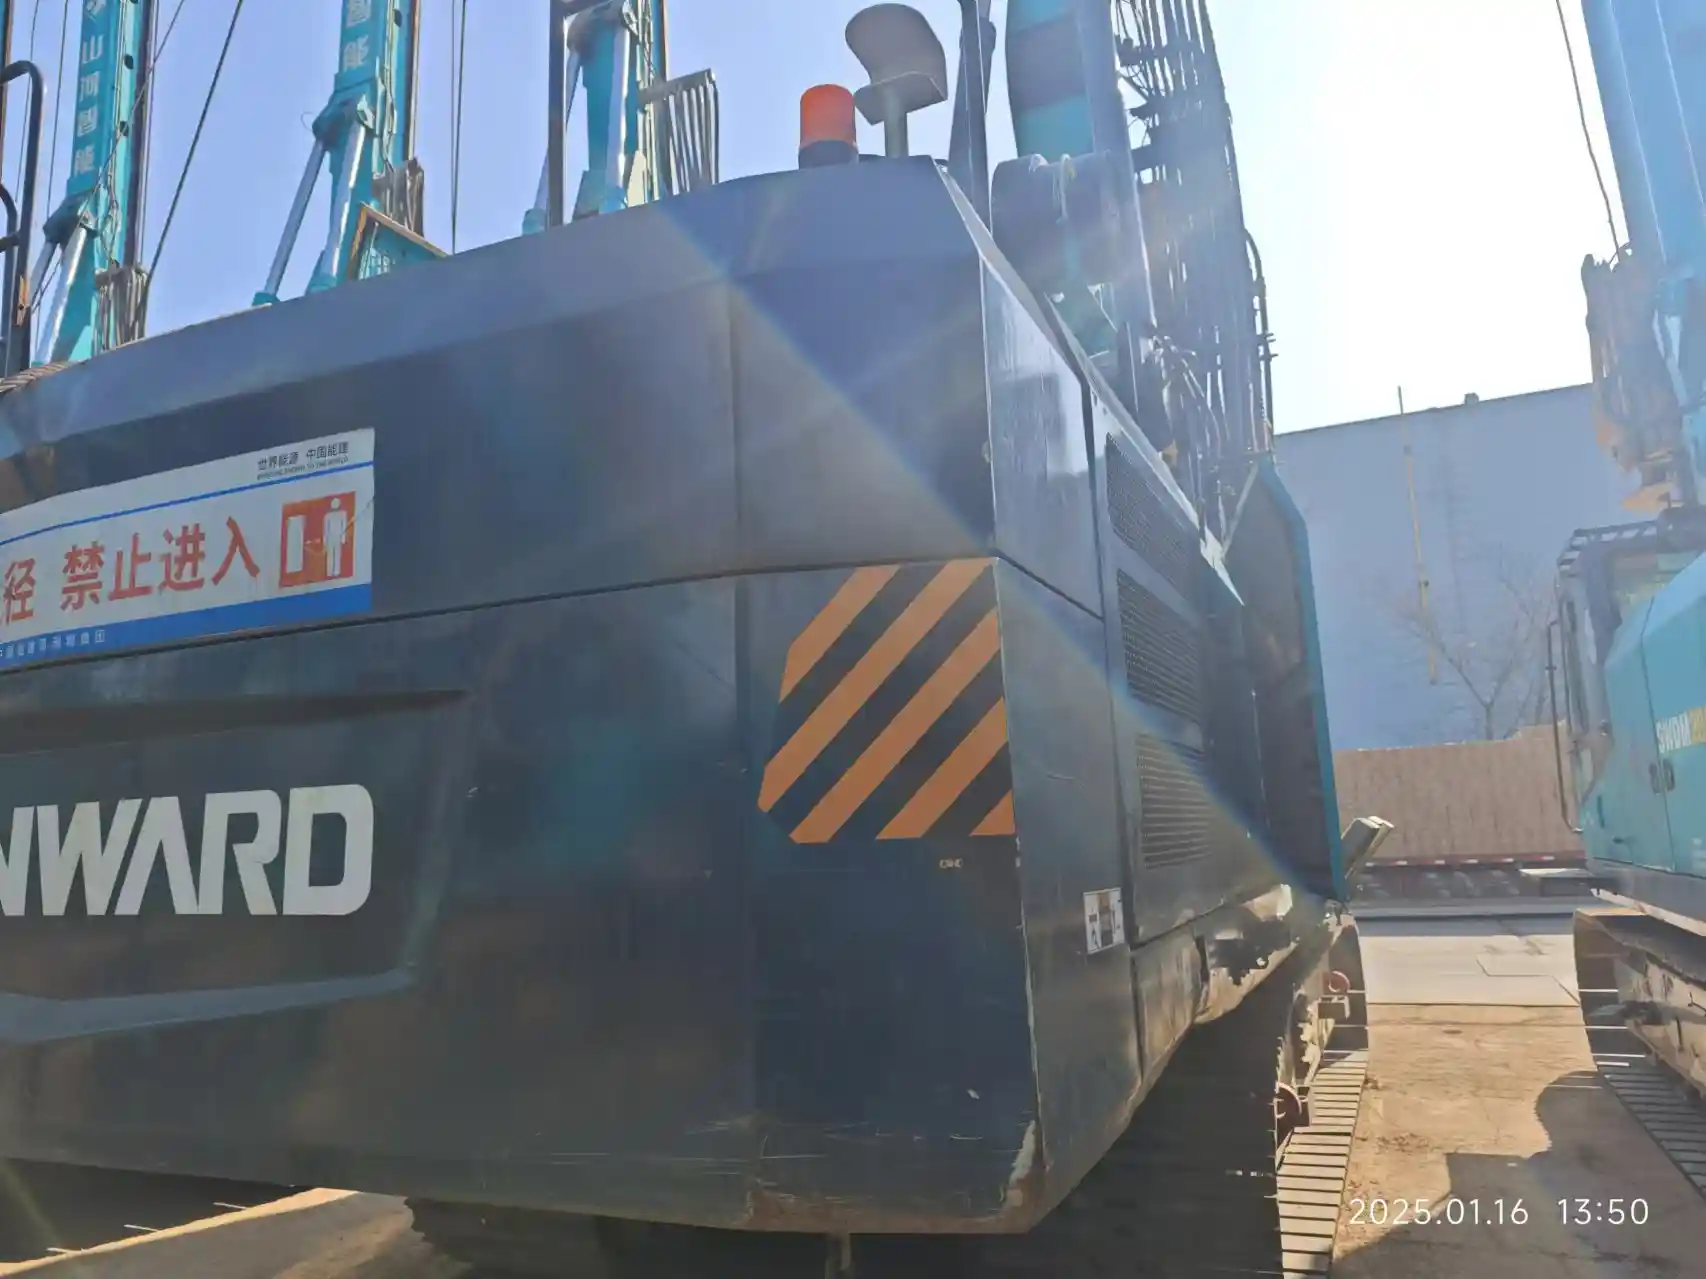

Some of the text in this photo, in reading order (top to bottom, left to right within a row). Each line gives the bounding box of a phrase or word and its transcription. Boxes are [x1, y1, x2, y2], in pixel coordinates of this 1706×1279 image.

[74, 34, 104, 176] 山河智能
[306, 441, 348, 461] 中国能建
[2, 516, 260, 626] 径 禁止进入
